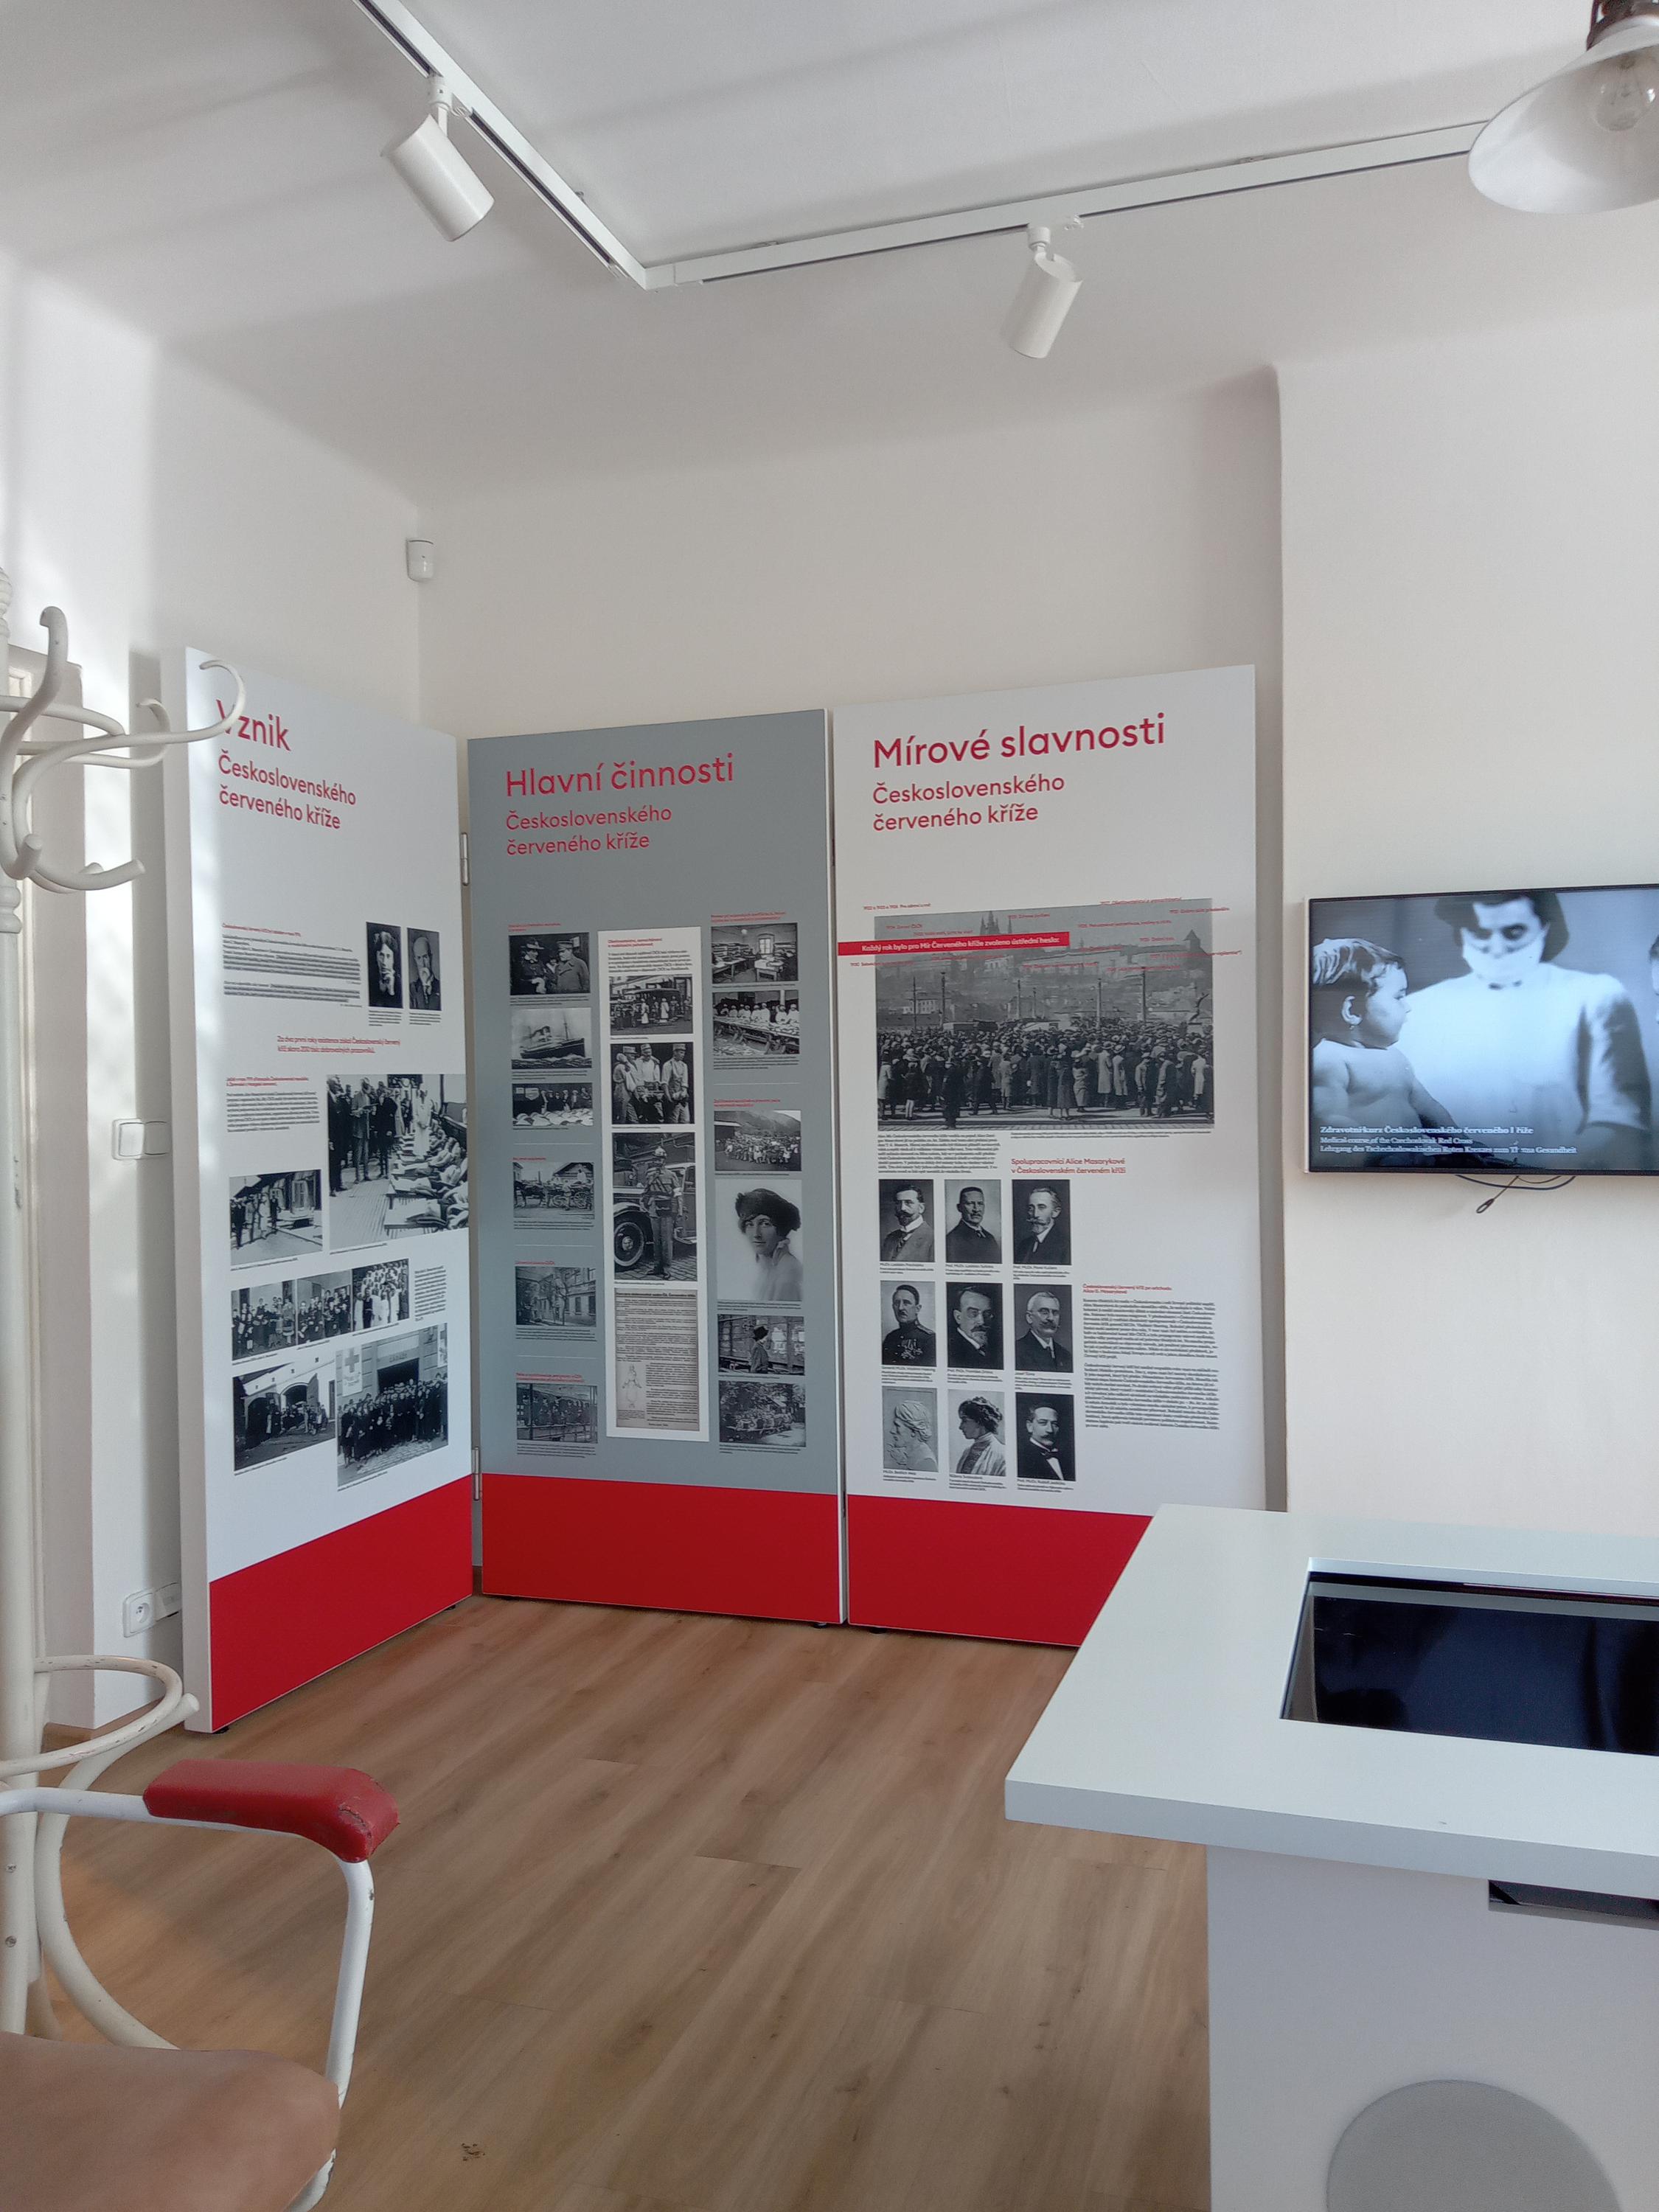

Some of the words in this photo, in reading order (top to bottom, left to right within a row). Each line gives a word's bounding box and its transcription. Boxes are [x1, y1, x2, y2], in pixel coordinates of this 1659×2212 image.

[874, 729, 991, 768] Mírové
[1001, 712, 1165, 759] slavnosti
[218, 748, 356, 806] Československého
[507, 762, 605, 797] Hlavní
[611, 752, 734, 791] činnosti
[872, 774, 1065, 805] Československého
[219, 784, 303, 821] červeného
[307, 804, 341, 829] kříže
[506, 805, 672, 831] Československého
[872, 810, 982, 832] červeného
[988, 804, 1039, 824] kříže
[507, 835, 601, 855] červeného
[606, 832, 650, 851] kříže
[1383, 1125, 1462, 1134] Československého
[1065, 1157, 1082, 1165] Alice
